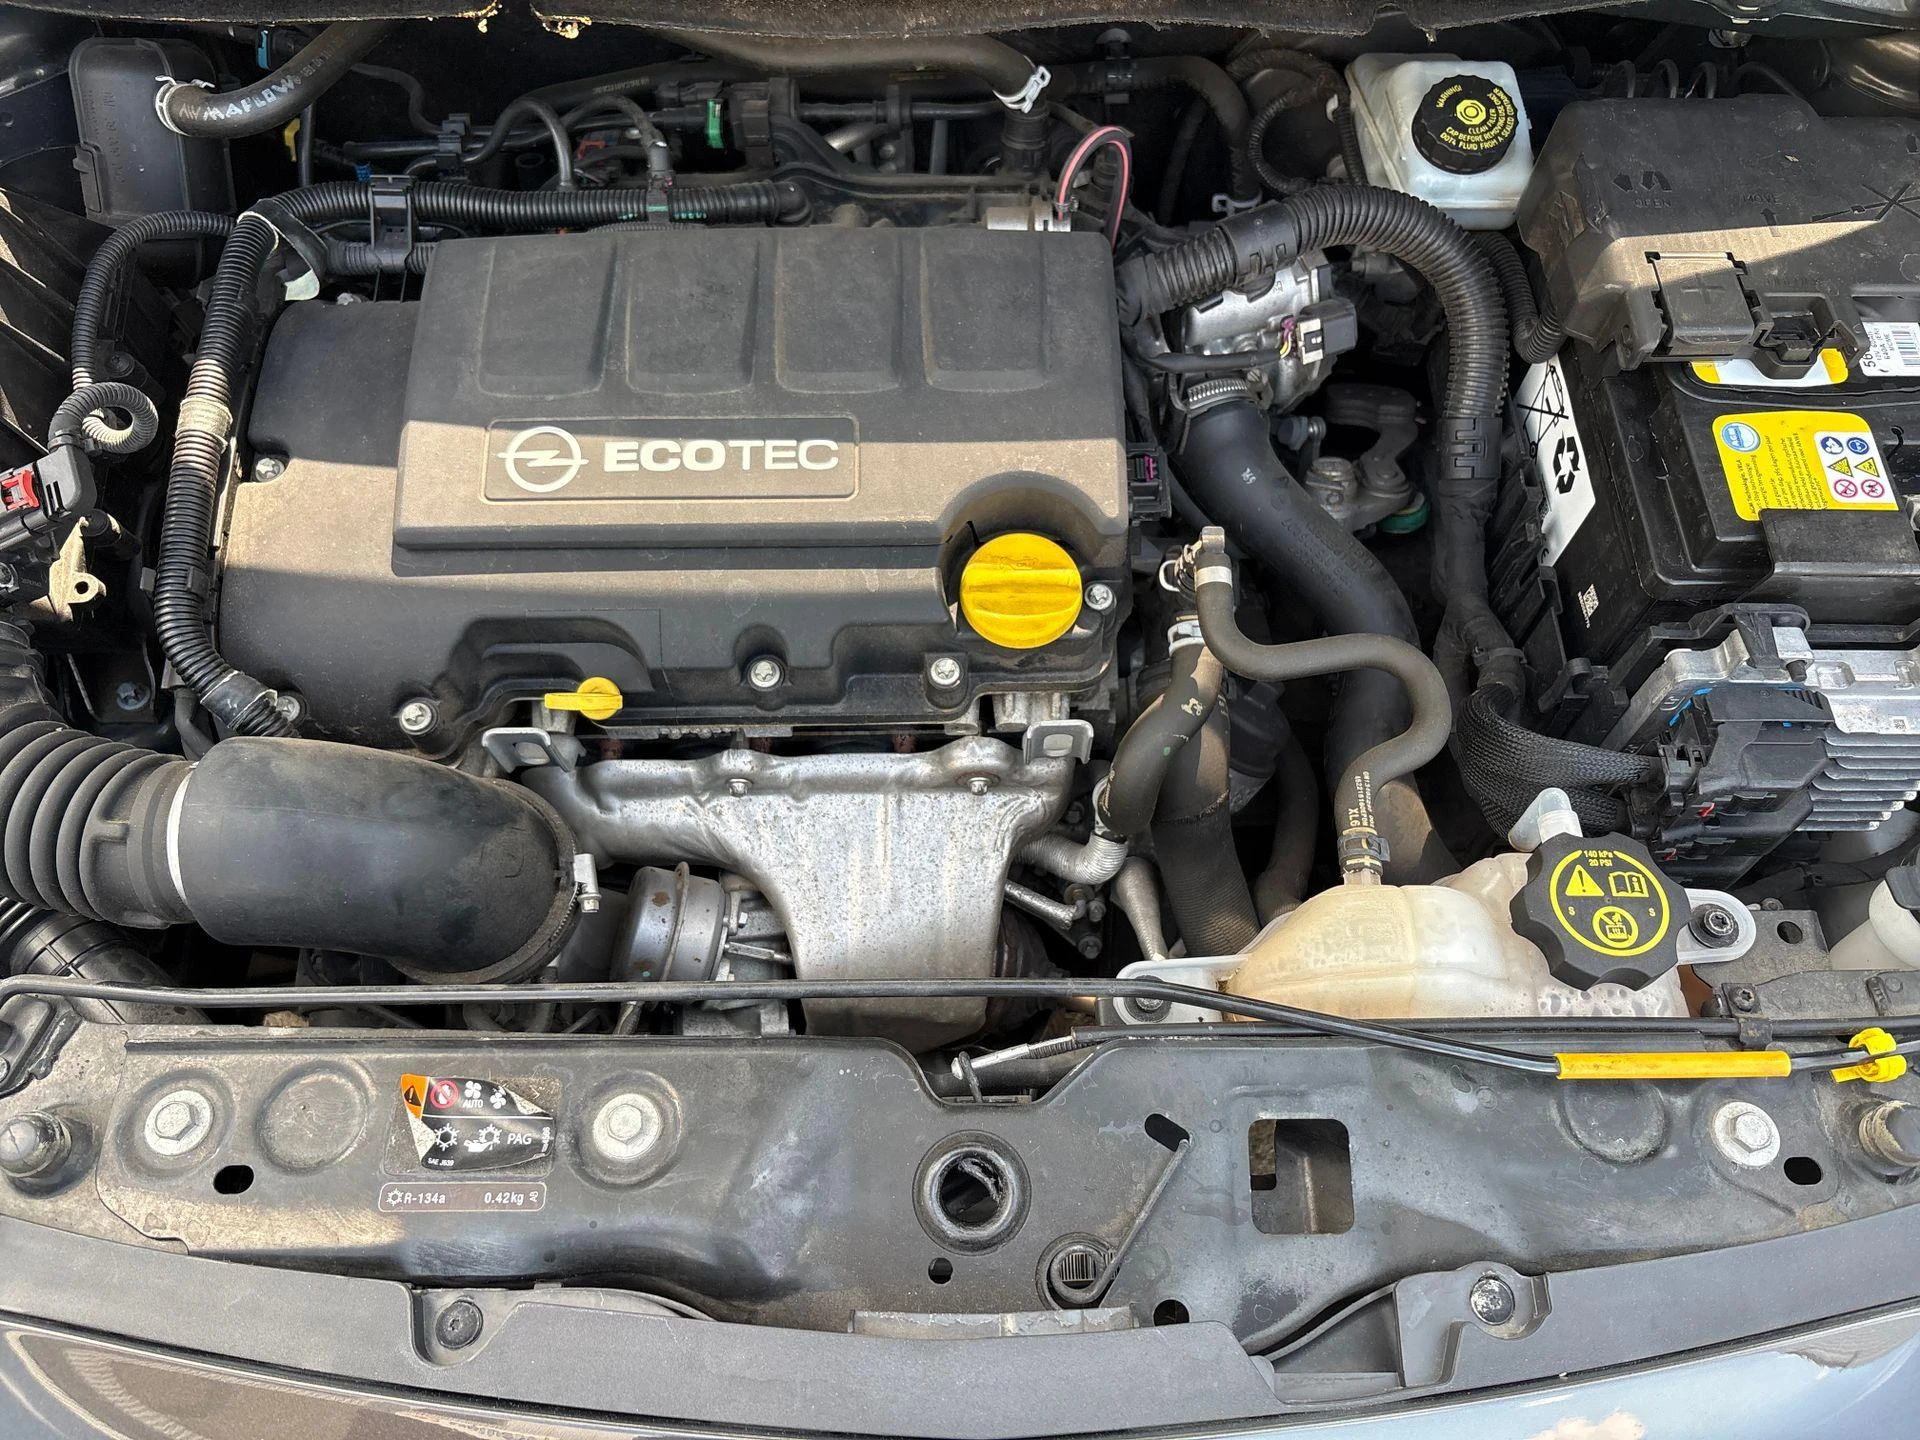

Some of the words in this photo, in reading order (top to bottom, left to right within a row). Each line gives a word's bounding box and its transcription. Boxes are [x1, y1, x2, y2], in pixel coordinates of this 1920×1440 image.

[203, 74, 296, 122] MAFLOW
[1436, 84, 1462, 108] WARNING!
[1468, 125, 1489, 135] CLEAN
[1486, 108, 1497, 130] FILLER
[1446, 126, 1459, 137] CAP
[1458, 133, 1483, 142] BEFORE
[1459, 141, 1478, 151] FLUID
[1480, 138, 1498, 150] FROM
[1501, 116, 1515, 138] SEALED
[603, 439, 839, 472] ECOTEC
[1583, 850, 1598, 858] 140
[1598, 850, 1614, 858] kPa
[1588, 859, 1599, 867] 20
[1600, 859, 1613, 867] PSI
[1568, 906, 1576, 916] S
[1648, 907, 1656, 917] S
[462, 1099, 484, 1109] AUTO
[507, 1133, 532, 1145] PAG
[427, 1157, 439, 1165] SAE
[403, 1192, 446, 1205] R-134a
[484, 1192, 525, 1205] 0.42kg
